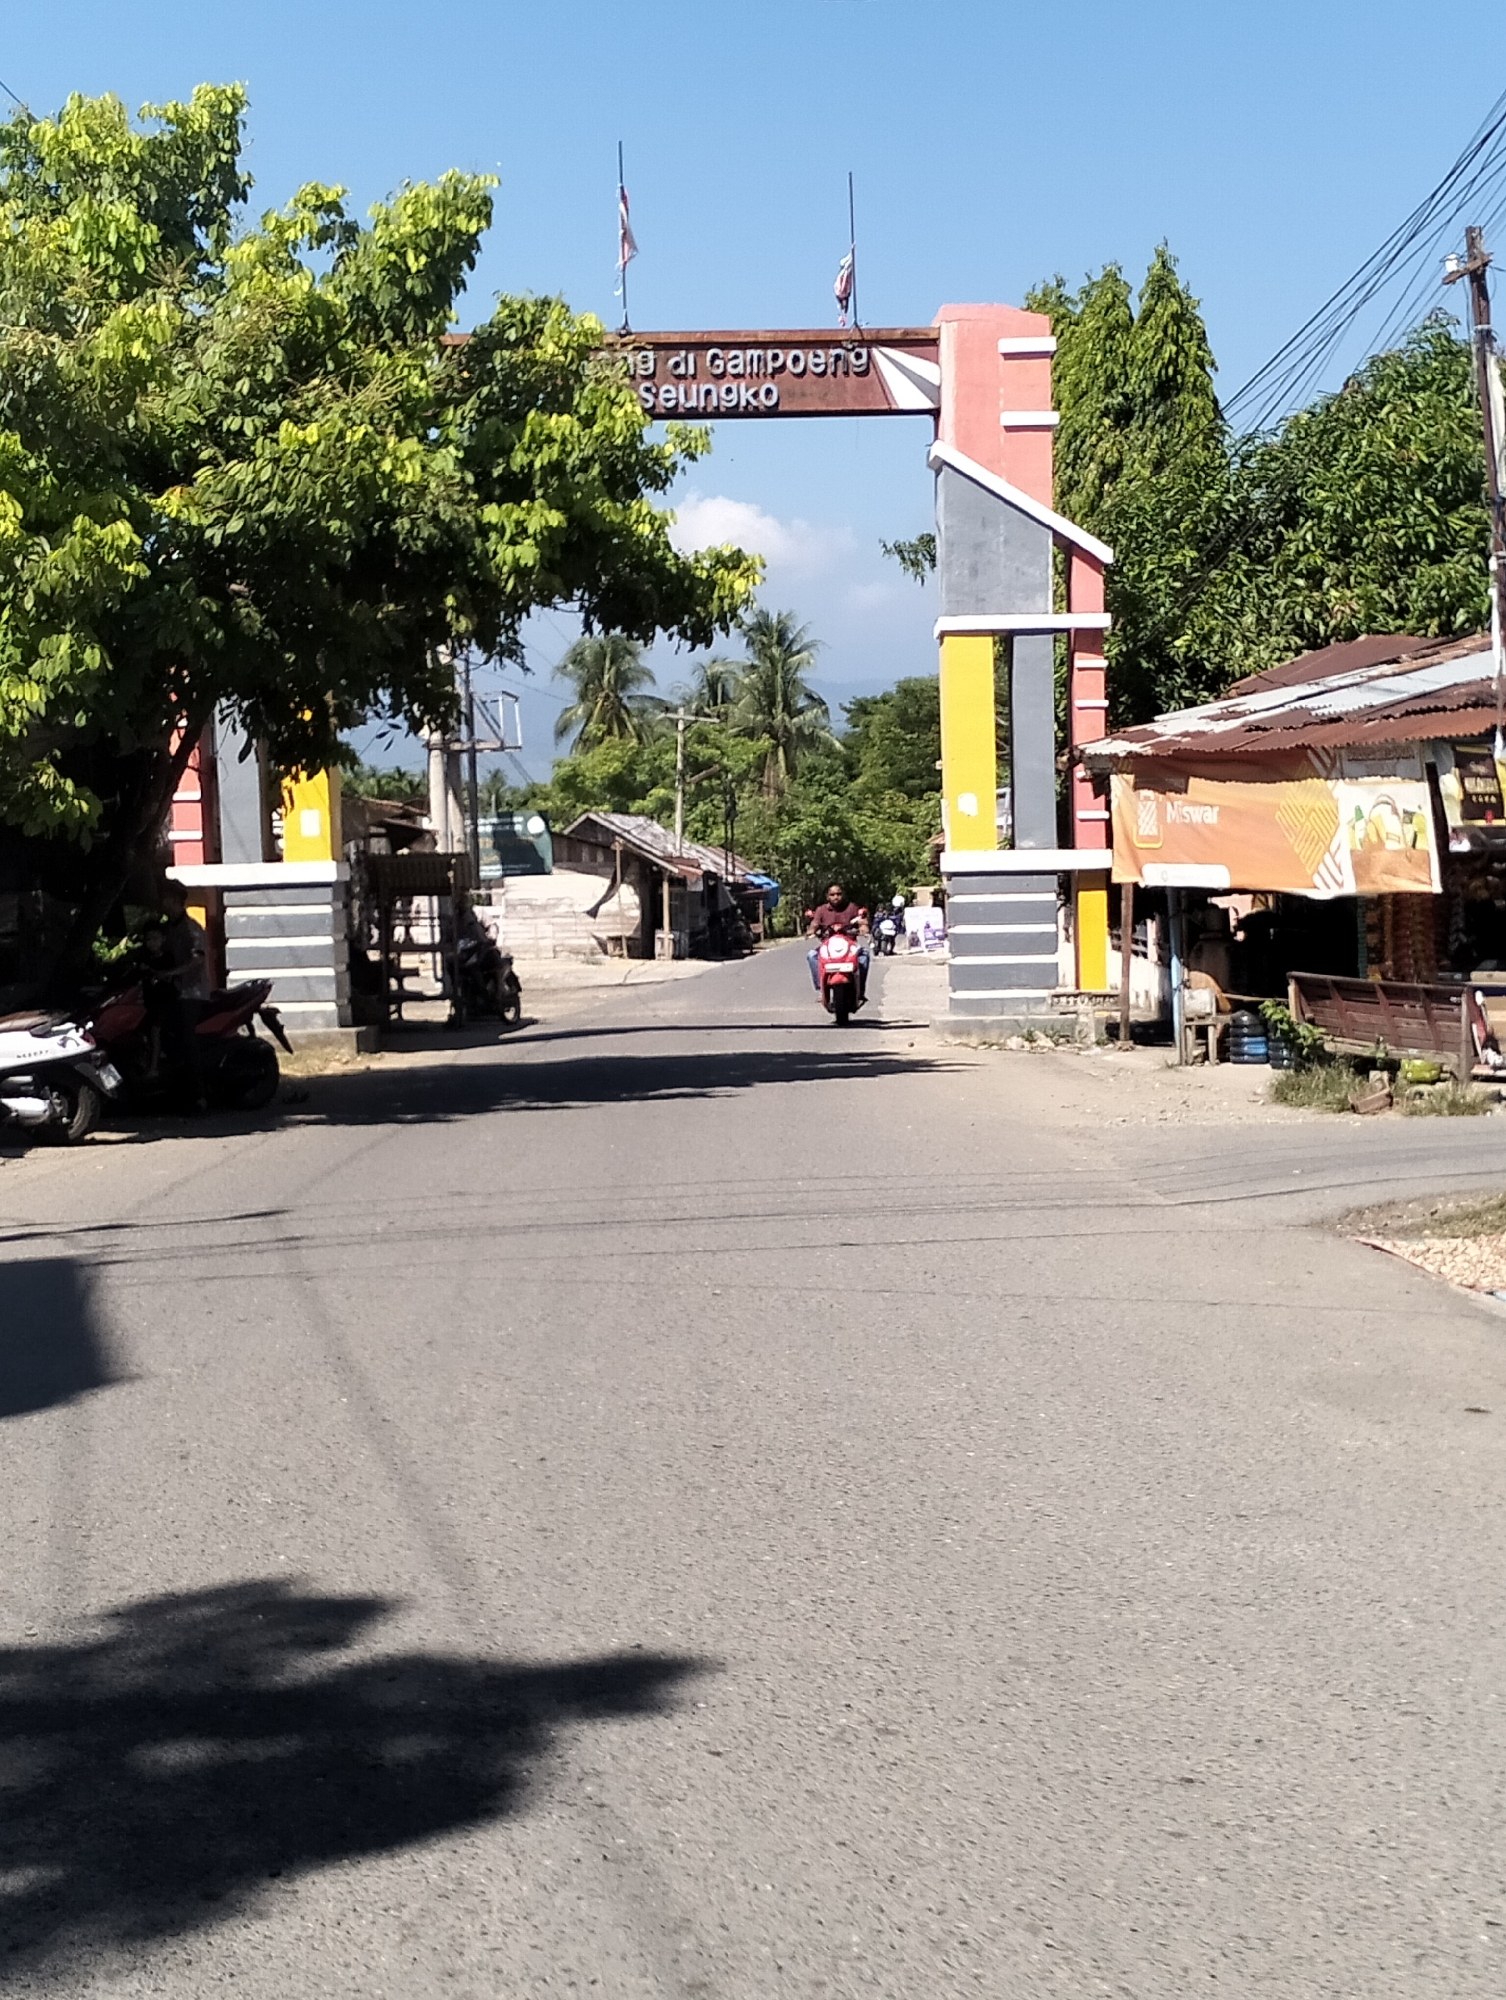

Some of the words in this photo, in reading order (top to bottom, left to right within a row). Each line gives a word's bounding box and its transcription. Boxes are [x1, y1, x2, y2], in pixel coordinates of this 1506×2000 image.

[667, 349, 696, 376] di
[706, 346, 869, 377] Gampoeng
[1166, 799, 1220, 824] Miswar
